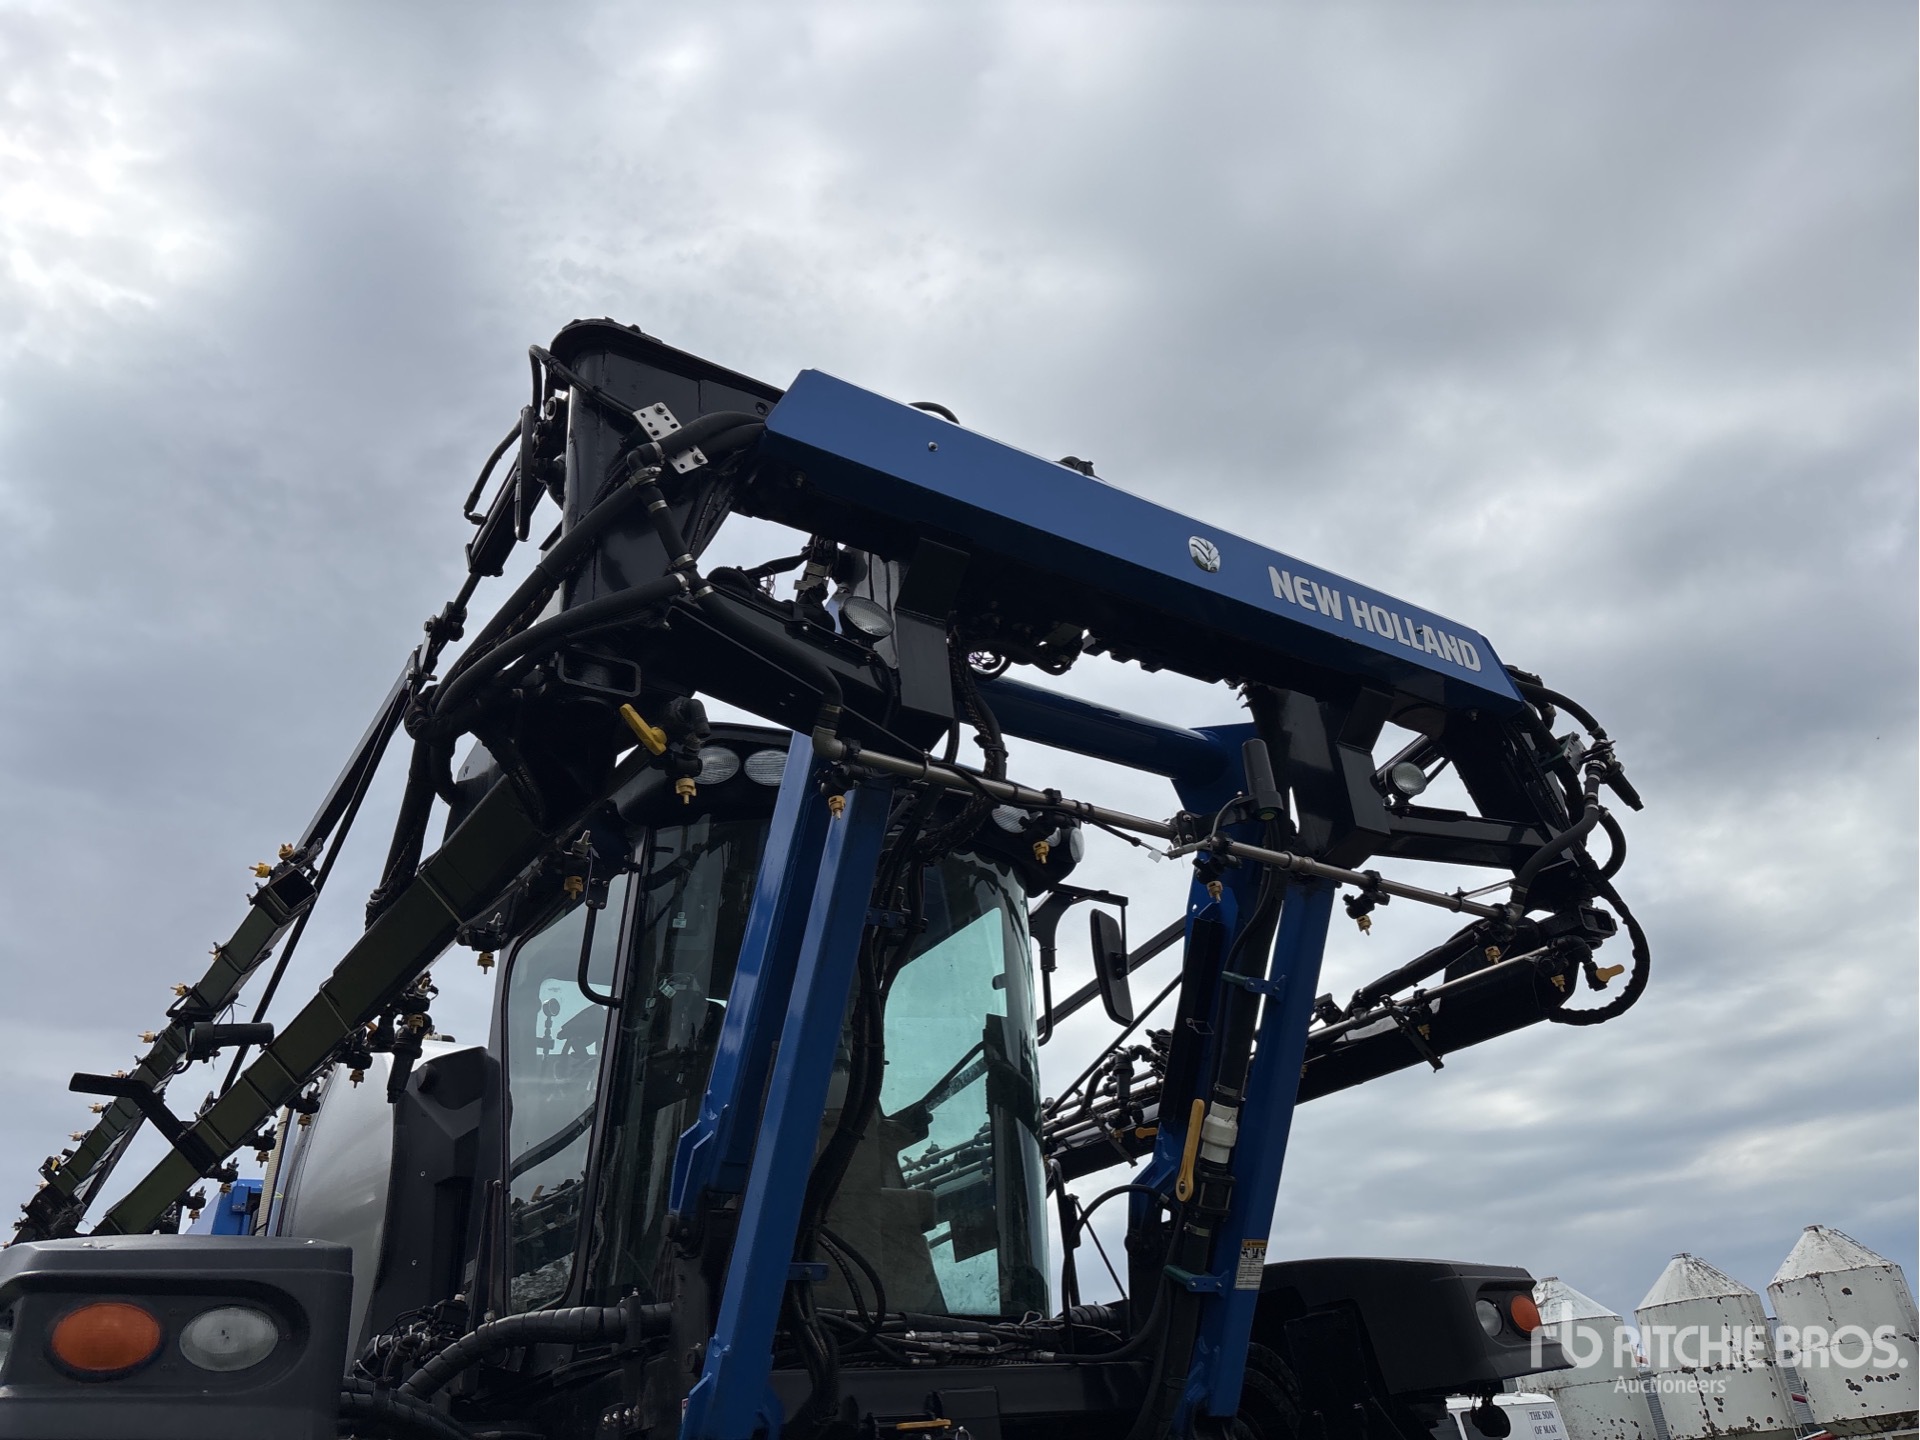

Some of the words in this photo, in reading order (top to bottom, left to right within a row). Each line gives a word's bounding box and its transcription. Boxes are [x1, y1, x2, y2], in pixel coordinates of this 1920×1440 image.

[1268, 565, 1343, 621] NEW
[1347, 595, 1482, 672] HOLLAND
[1529, 1411, 1543, 1420] THE
[1542, 1410, 1555, 1419] SON
[1535, 1425, 1543, 1434] OF
[1543, 1424, 1557, 1434] MAN
